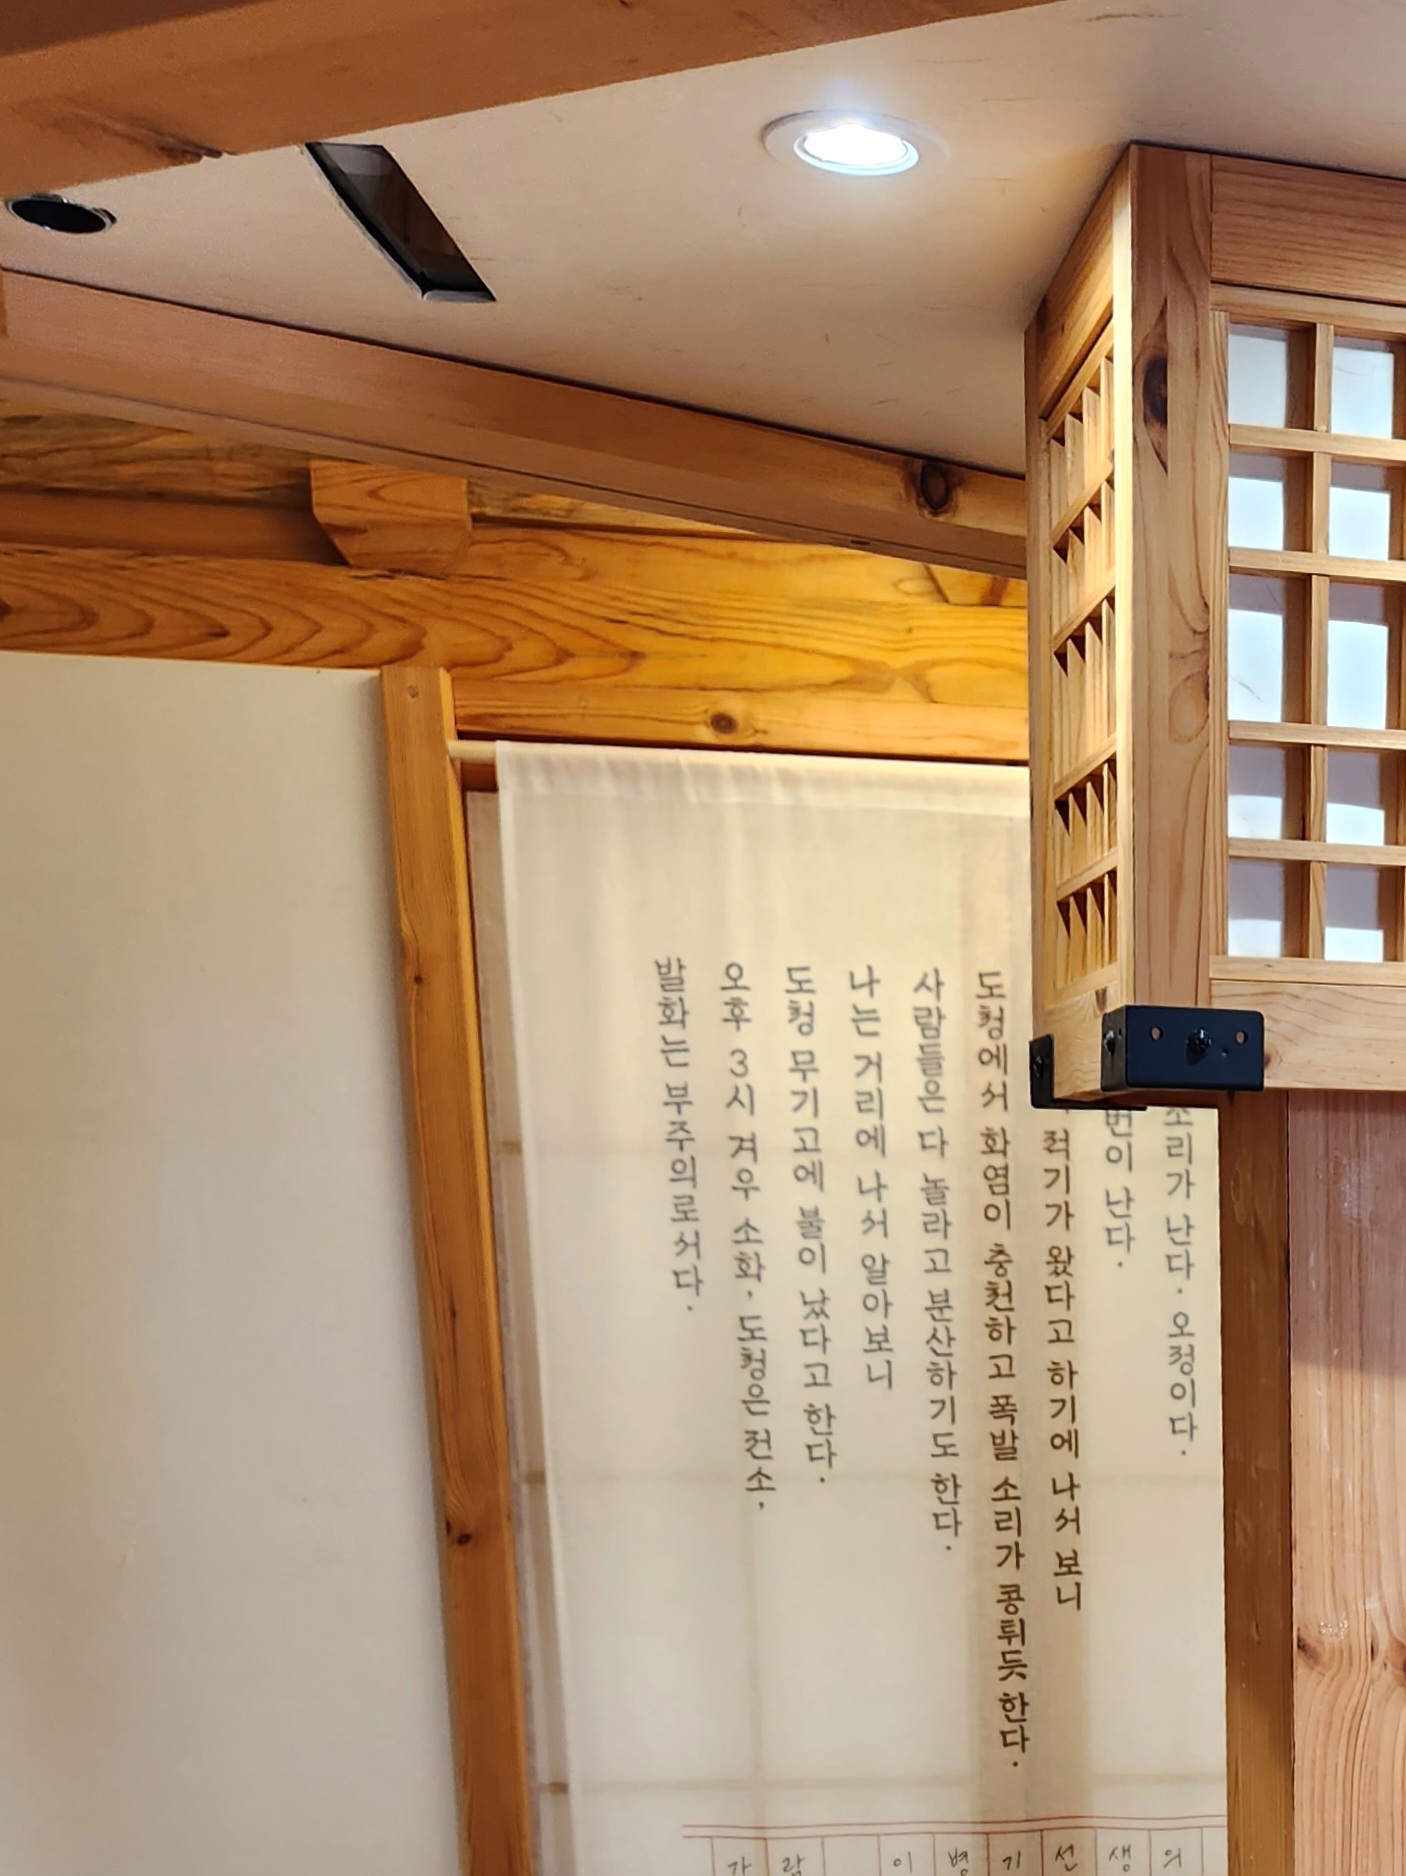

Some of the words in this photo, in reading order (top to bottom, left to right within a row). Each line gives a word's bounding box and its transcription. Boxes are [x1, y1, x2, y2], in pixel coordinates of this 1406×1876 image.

[654, 957, 690, 1068] 발화는
[720, 962, 752, 1032] 오후
[785, 966, 816, 1036] 도청
[849, 964, 881, 1037] 나는
[912, 967, 947, 1114] 사람들은
[975, 971, 1008, 1112] 도청에서
[725, 1049, 755, 1117] 3시
[788, 1050, 824, 1192] 무기고에
[854, 1051, 886, 1158] 거리에
[728, 1132, 760, 1201] 겨우
[917, 1126, 949, 1159] 다
[980, 1126, 1011, 1231] 화염이
[1043, 1128, 1075, 1232] 적기가
[796, 1205, 826, 1274] 불이
[857, 1170, 888, 1239] 나서
[920, 1172, 952, 1274] 놀라고
[1105, 1186, 1135, 1269] 난다.
[1044, 1245, 1076, 1344] 왔다고
[1165, 1214, 1195, 1295] 난다.
[799, 1288, 832, 1388] 났다고
[861, 1253, 894, 1390] 알아보니
[984, 1243, 1017, 1379] 충천하고
[737, 1315, 771, 1416] 도청은
[924, 1289, 959, 1458] 분산하기도
[1047, 1360, 1079, 1459] 하기에
[1168, 1311, 1198, 1457] 오정이다.
[803, 1403, 837, 1484] 한다.
[988, 1394, 1019, 1461] 폭발
[930, 1472, 962, 1552] 한다.
[991, 1476, 1026, 1571] 소리가
[1051, 1472, 1081, 1535] 나서
[1053, 1549, 1083, 1611] 보니
[998, 1692, 1030, 1768] 한다.
